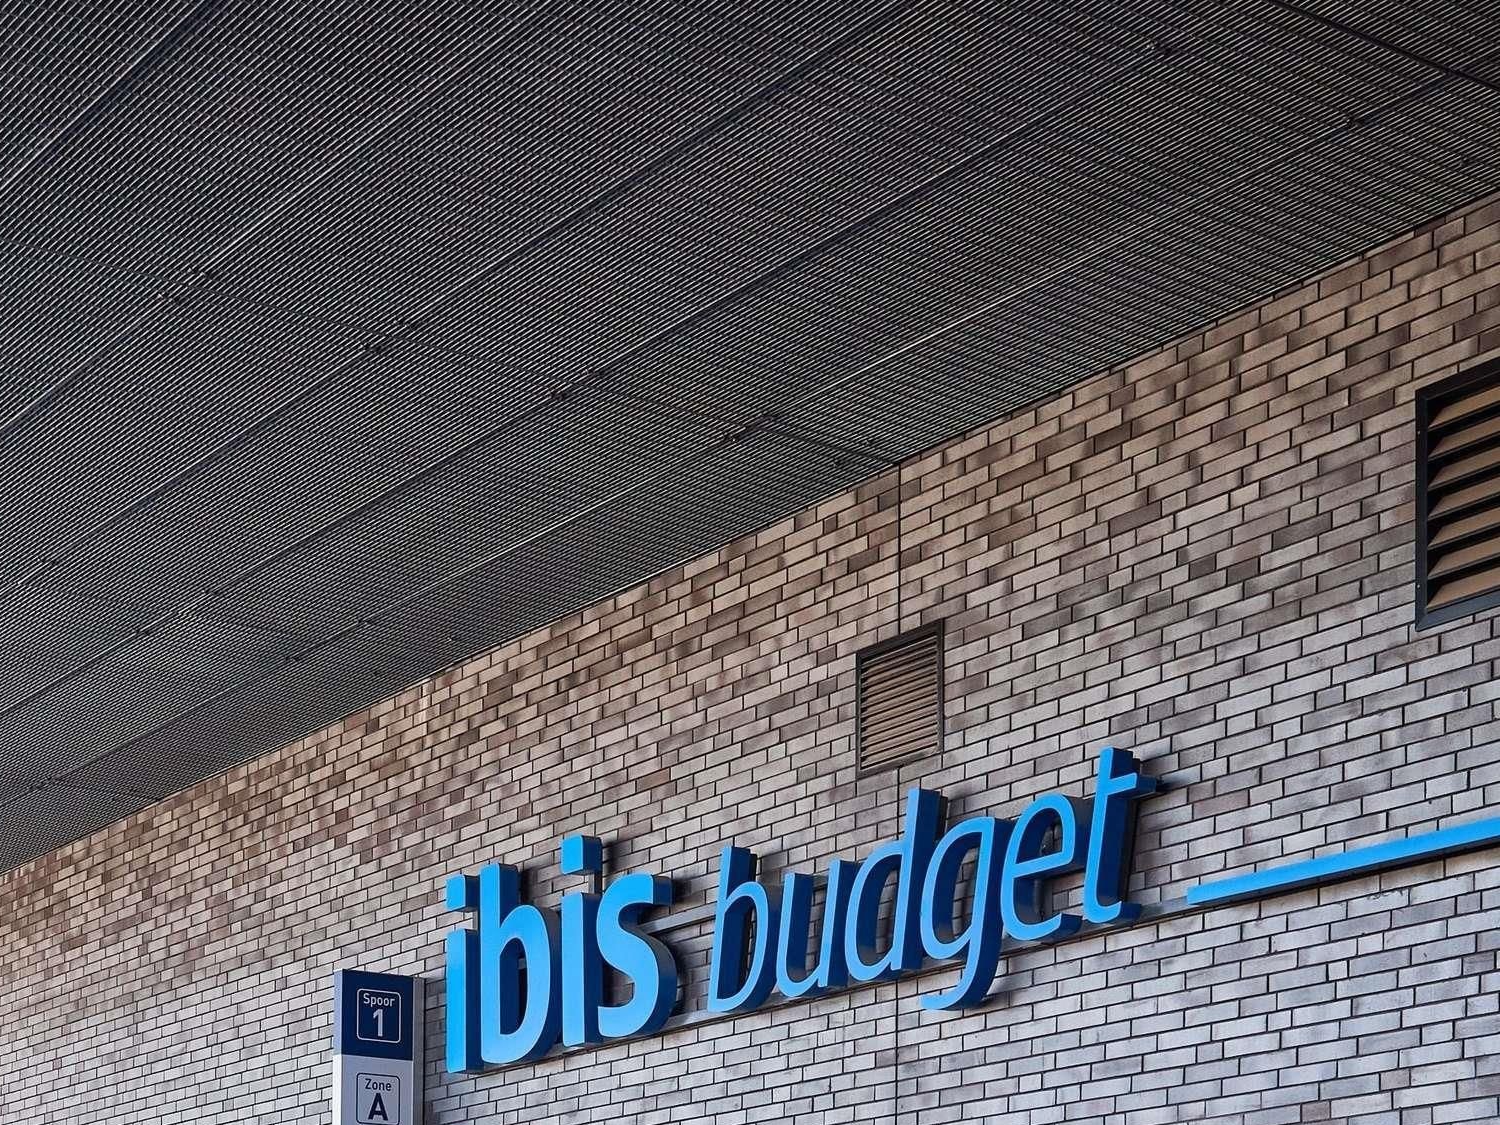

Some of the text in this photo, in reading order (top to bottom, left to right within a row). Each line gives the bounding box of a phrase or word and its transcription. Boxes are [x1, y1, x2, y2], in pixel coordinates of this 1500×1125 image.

[445, 746, 1150, 1075] ibis budget
[363, 992, 396, 1008] Spoor
[372, 1008, 384, 1038] 1
[365, 1078, 392, 1092] Zone
[367, 1092, 389, 1121] A
